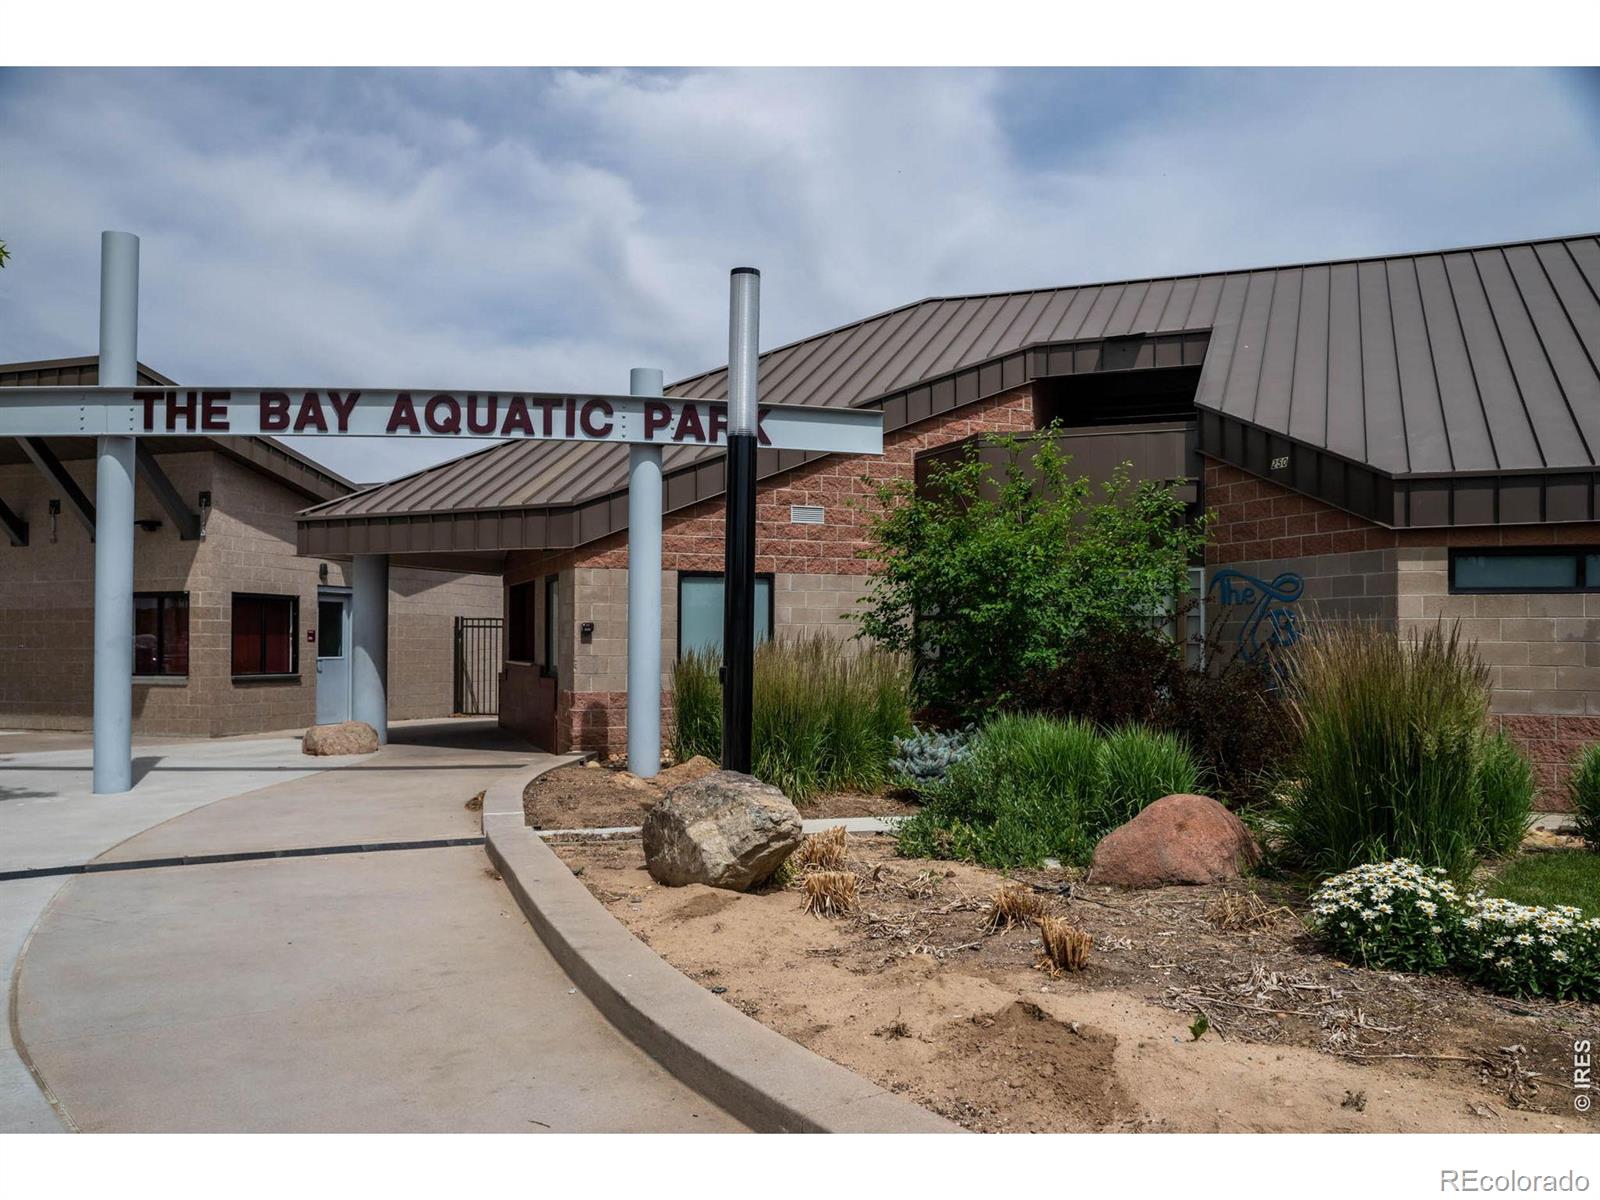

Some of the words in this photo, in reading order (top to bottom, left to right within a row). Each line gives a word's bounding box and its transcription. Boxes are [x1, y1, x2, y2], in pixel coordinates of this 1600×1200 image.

[133, 391, 231, 431] THE
[259, 391, 361, 432] BAY
[386, 393, 614, 437] AQUATIC
